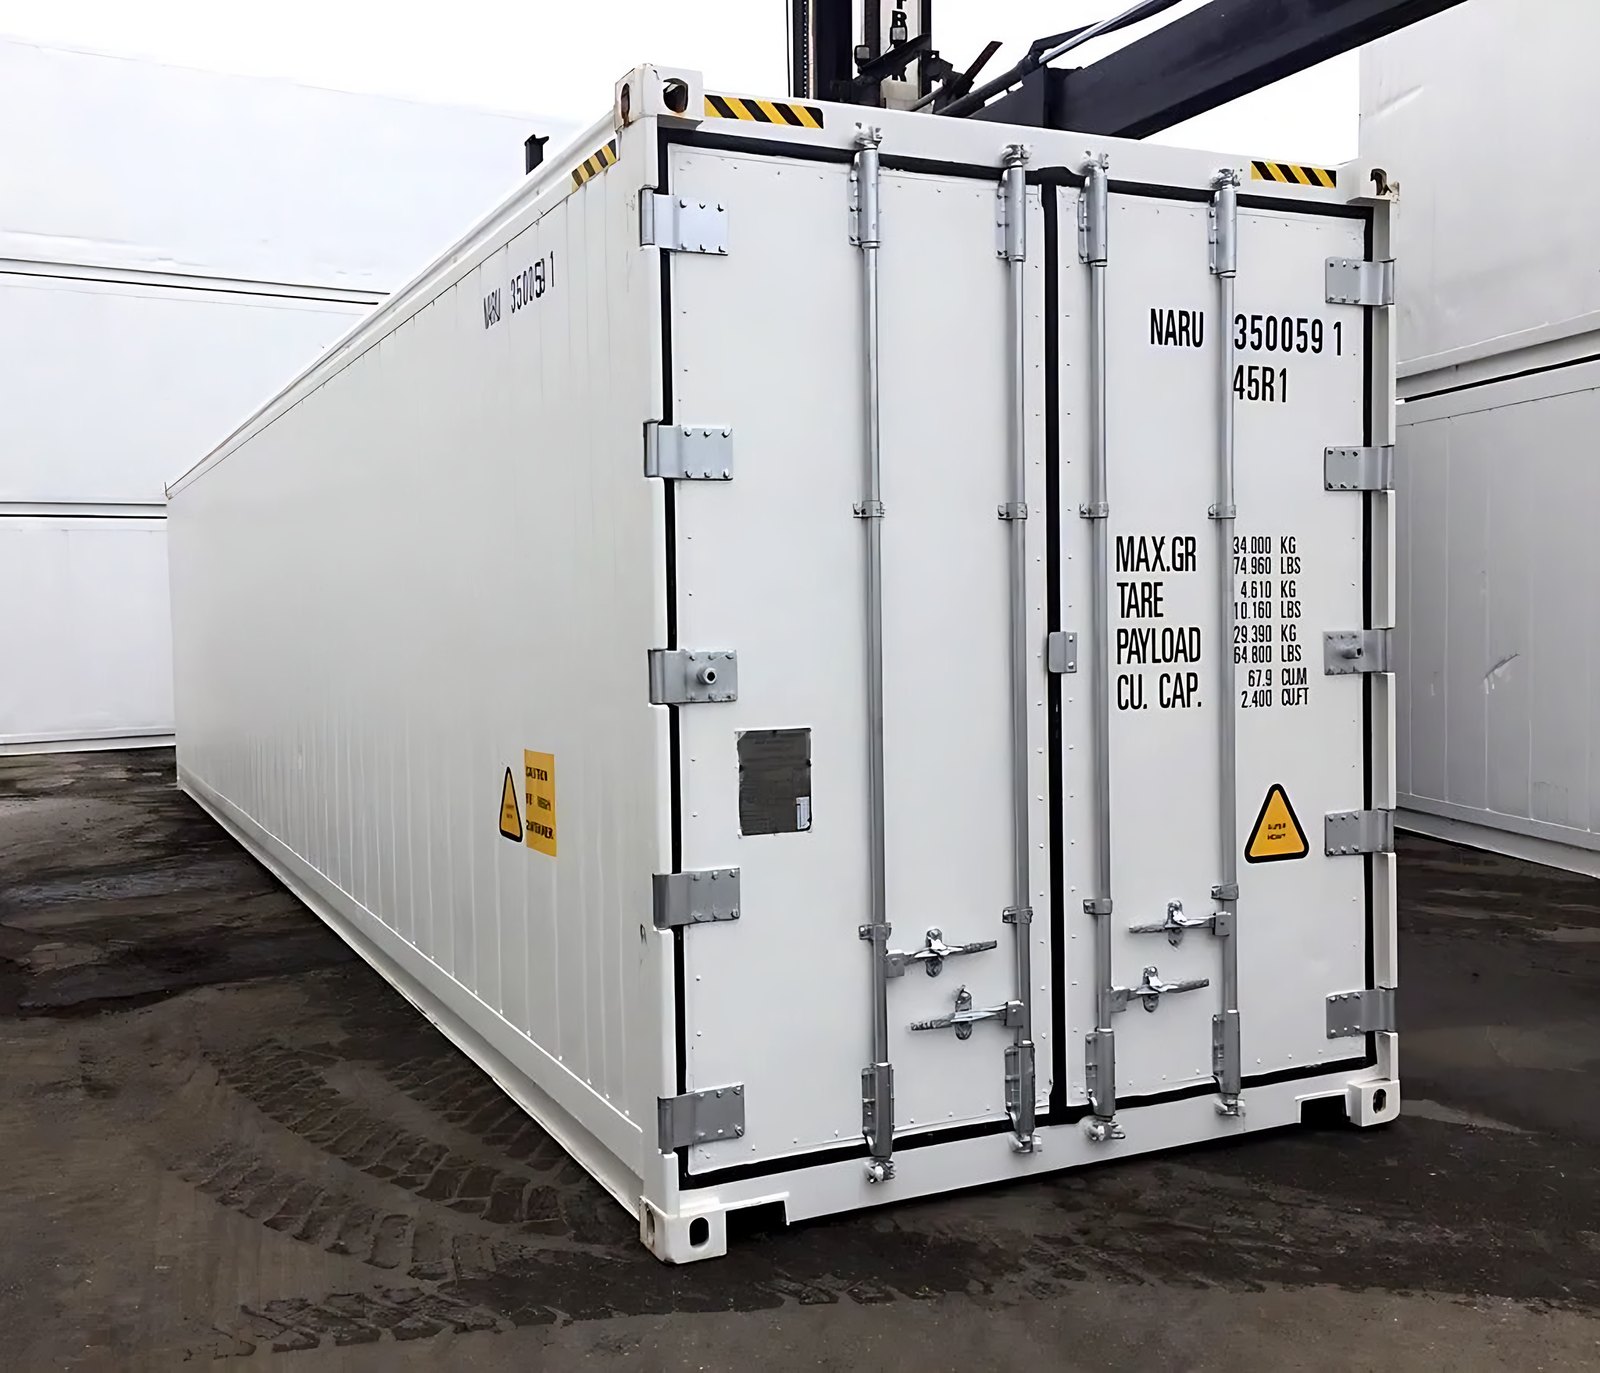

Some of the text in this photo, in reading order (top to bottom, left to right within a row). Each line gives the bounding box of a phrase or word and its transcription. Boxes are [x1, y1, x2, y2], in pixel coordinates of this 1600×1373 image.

[1150, 308, 1342, 356] NARU 350059 1
[1233, 364, 1287, 403] 45R1
[1115, 535, 1197, 573] MAX.GR
[1233, 535, 1296, 555] 34.000 KG
[1233, 556, 1301, 575] 74.960 LBS
[1240, 579, 1296, 599] 4.610 KG
[1116, 581, 1164, 619] TARE
[1233, 600, 1302, 620] 10.160 LBS
[1233, 623, 1297, 644] 29.390 KG
[1116, 626, 1201, 665] PAYLOAD
[1233, 644, 1302, 665] 64.800 LBS
[1248, 668, 1272, 687] 67.9
[1117, 672, 1202, 711] CU. CAP.
[1241, 689, 1272, 708] 2.400
